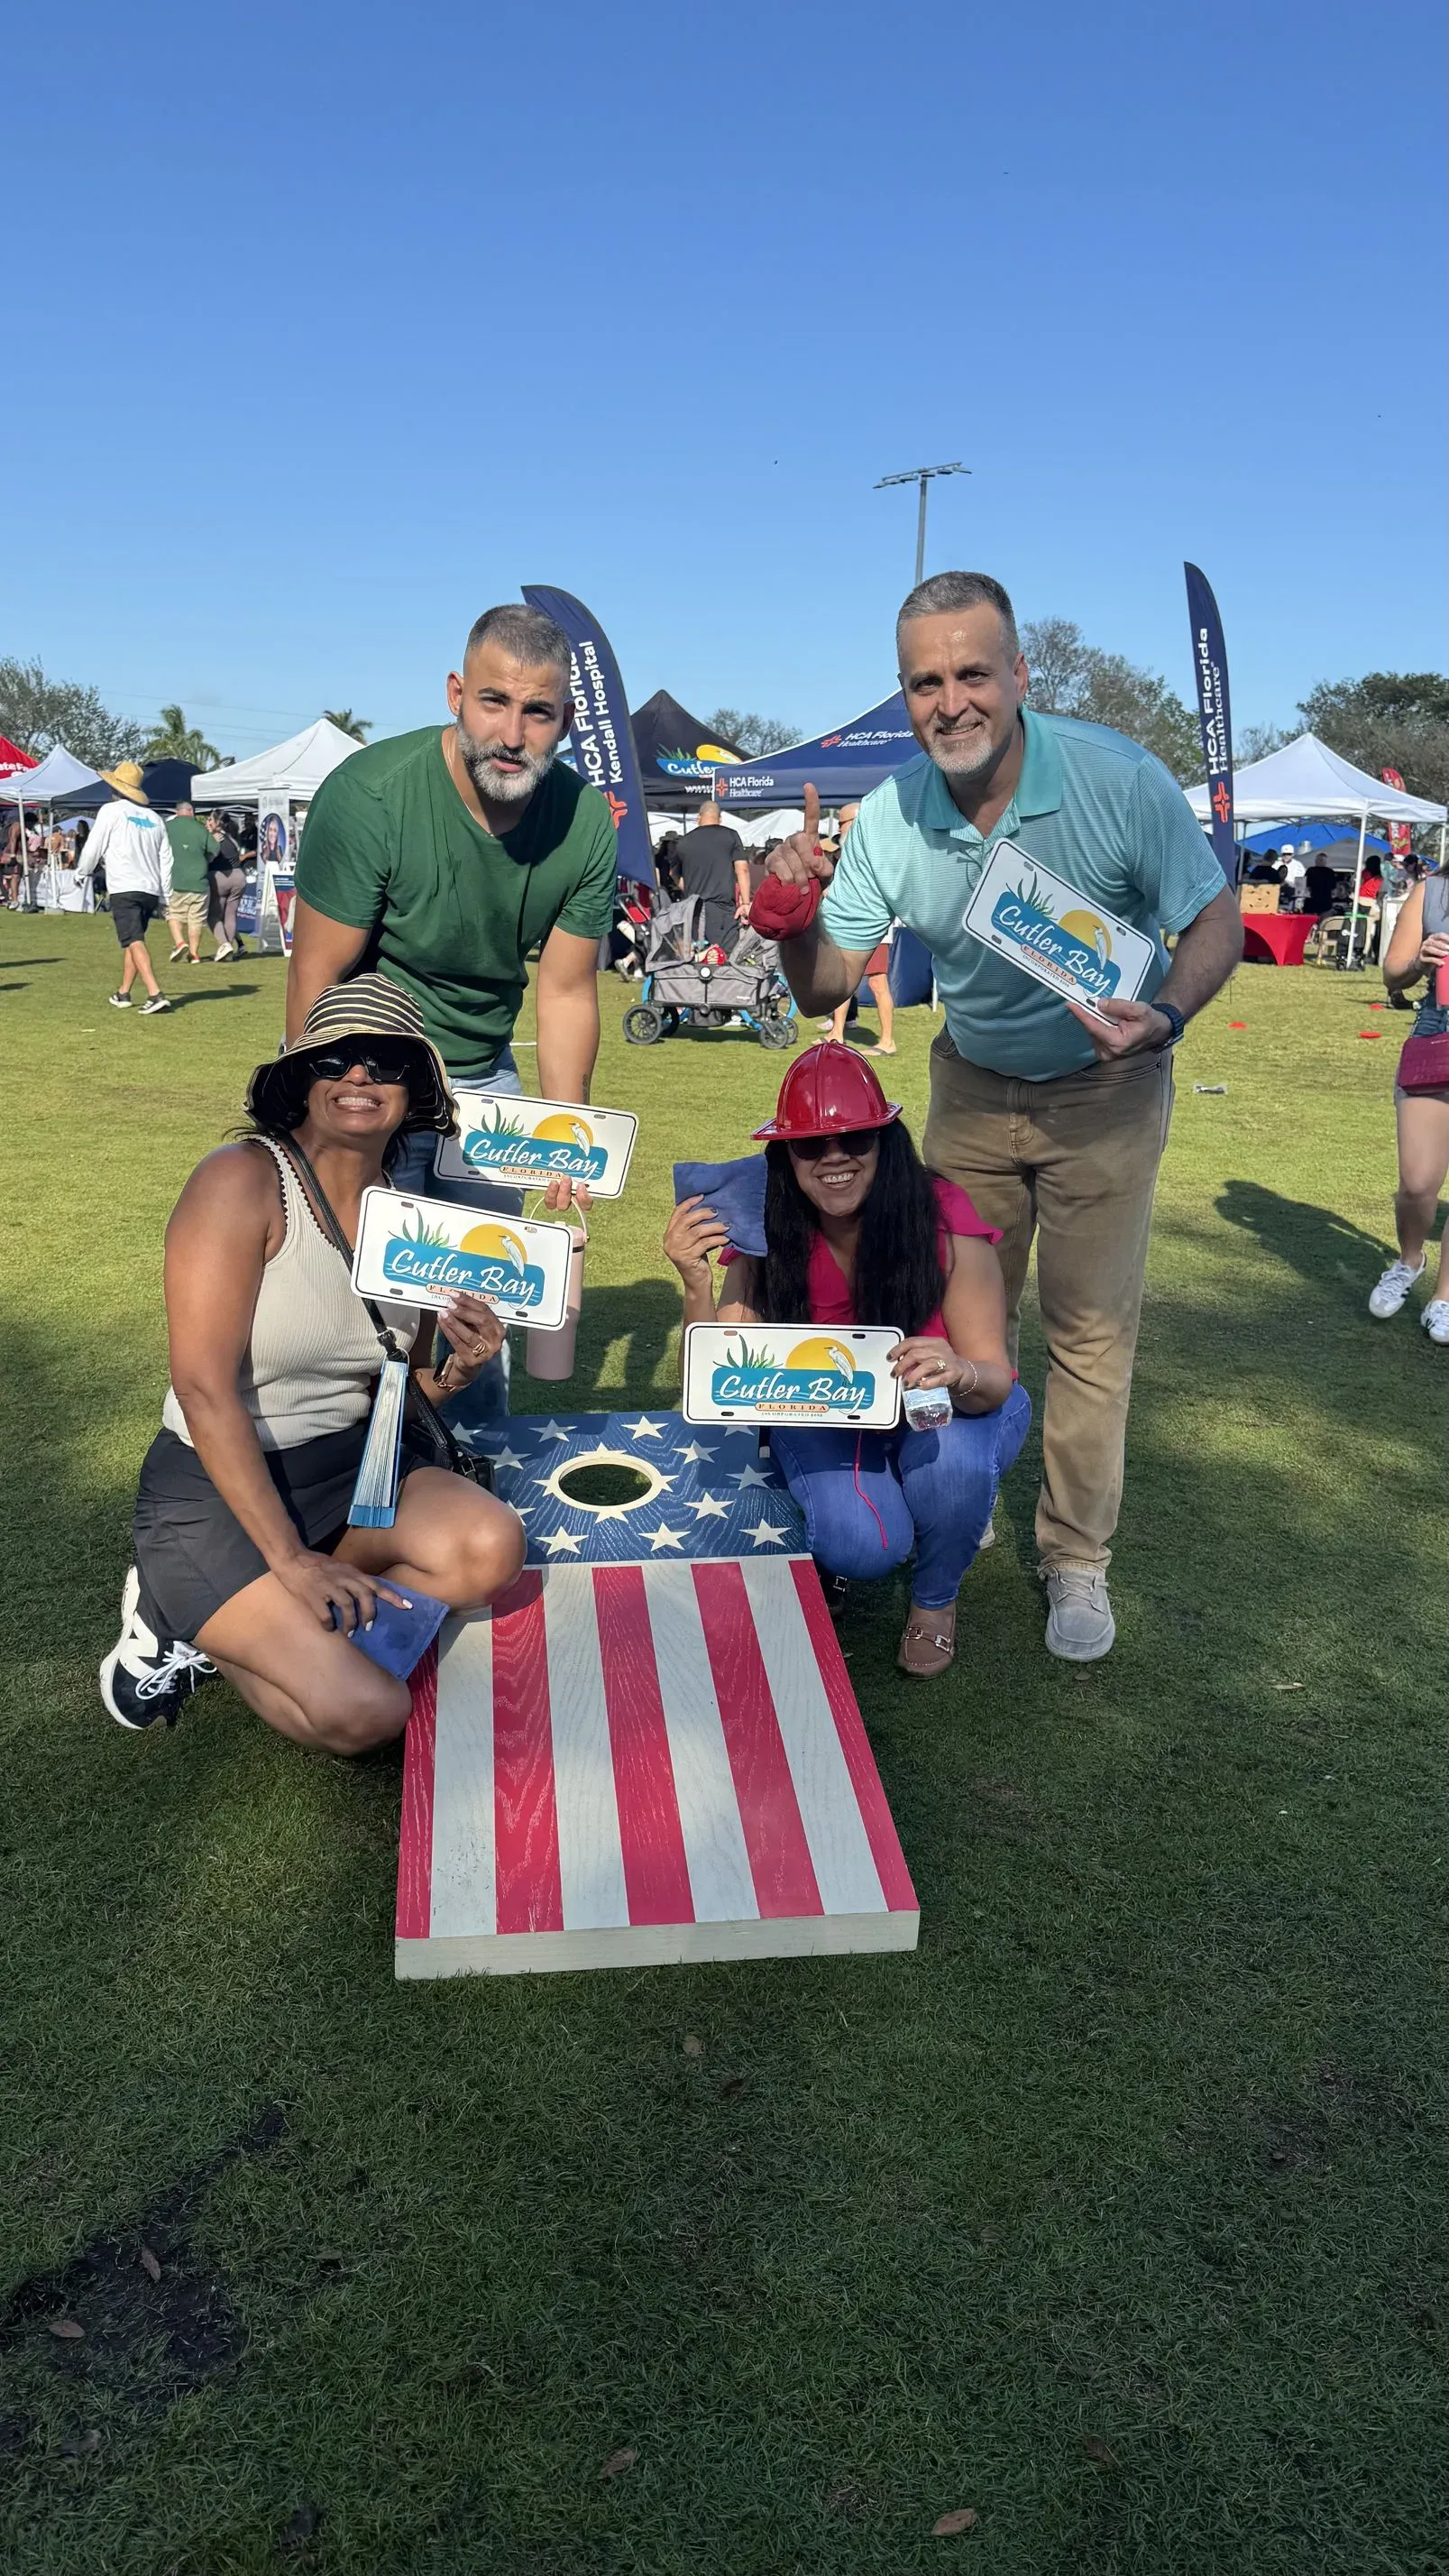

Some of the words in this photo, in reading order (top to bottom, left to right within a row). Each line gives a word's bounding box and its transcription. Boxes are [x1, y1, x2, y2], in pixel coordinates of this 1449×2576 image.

[579, 640, 609, 716] Hospital
[1198, 628, 1214, 714] Florida
[581, 733, 606, 787] HCA
[598, 719, 623, 784] Kendall
[845, 731, 872, 741] HCA
[1206, 719, 1220, 775] HCA
[729, 777, 747, 787] HCA
[747, 776, 774, 787] Florida
[998, 905, 1063, 956] Cutler
[1064, 949, 1111, 998] Bay
[1023, 945, 1075, 983] FLORIDA
[470, 1138, 543, 1166] Cutler
[548, 1148, 599, 1183] Bay
[502, 1166, 562, 1178] FLORIDA
[391, 1249, 473, 1285] Cutler
[481, 1265, 537, 1311] Bay
[720, 1371, 801, 1401] Cutler
[808, 1377, 867, 1414] Bay
